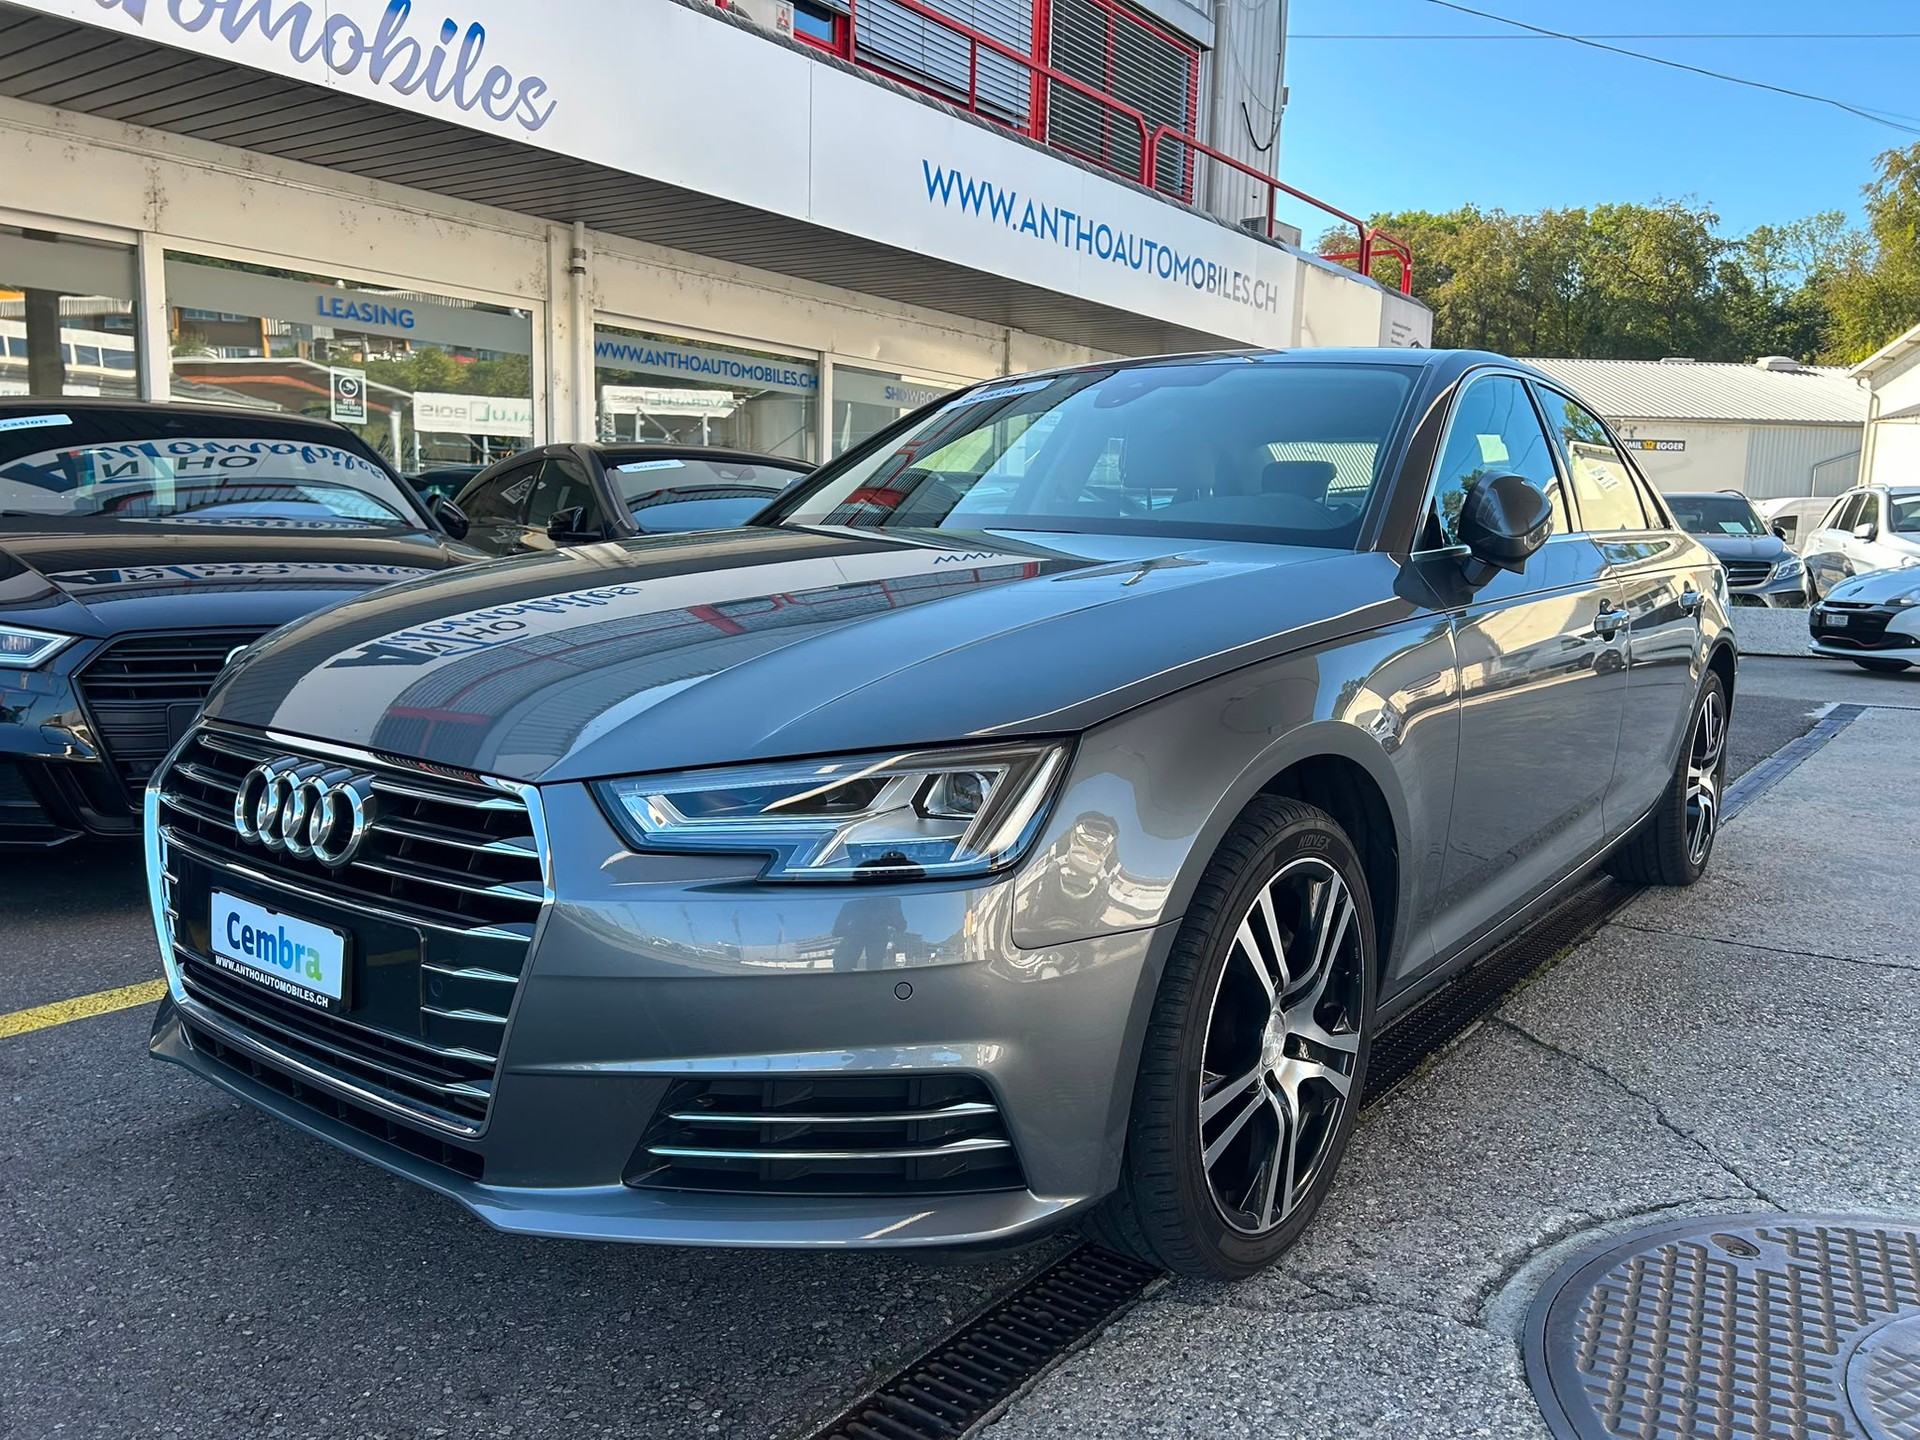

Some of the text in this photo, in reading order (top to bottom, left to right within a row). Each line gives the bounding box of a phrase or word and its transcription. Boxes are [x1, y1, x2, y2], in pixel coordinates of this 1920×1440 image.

[922, 159, 1278, 313] WWW.ANTHOAUTOMOBILES.CH
[317, 296, 415, 329] LEASING
[594, 342, 818, 389] WWW.ANTHOAUTOMOBILES.CH
[1656, 441, 1684, 450] EGGER
[226, 911, 322, 981] Cembra
[215, 954, 329, 1008] WWW.ANTHOAUTOMOBILES.CH
